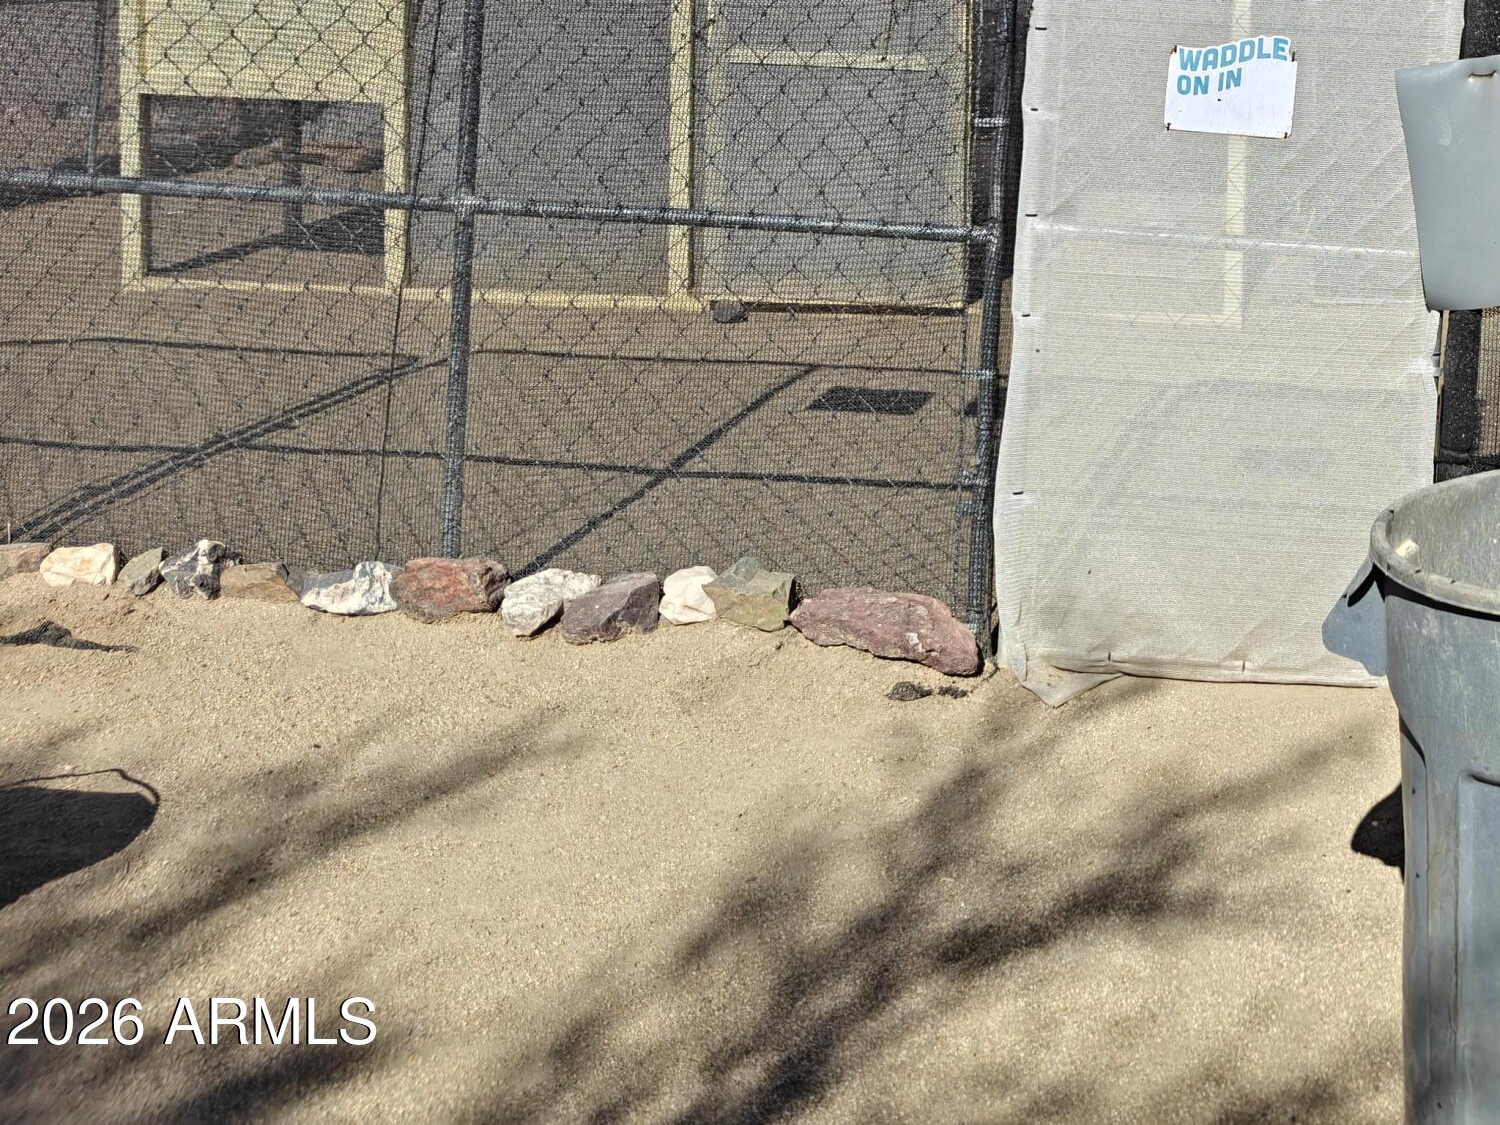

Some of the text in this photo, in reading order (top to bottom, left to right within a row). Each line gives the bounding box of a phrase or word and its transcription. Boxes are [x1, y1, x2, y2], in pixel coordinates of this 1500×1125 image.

[1179, 37, 1289, 72] WADDLE
[1177, 68, 1242, 95] ON IN
